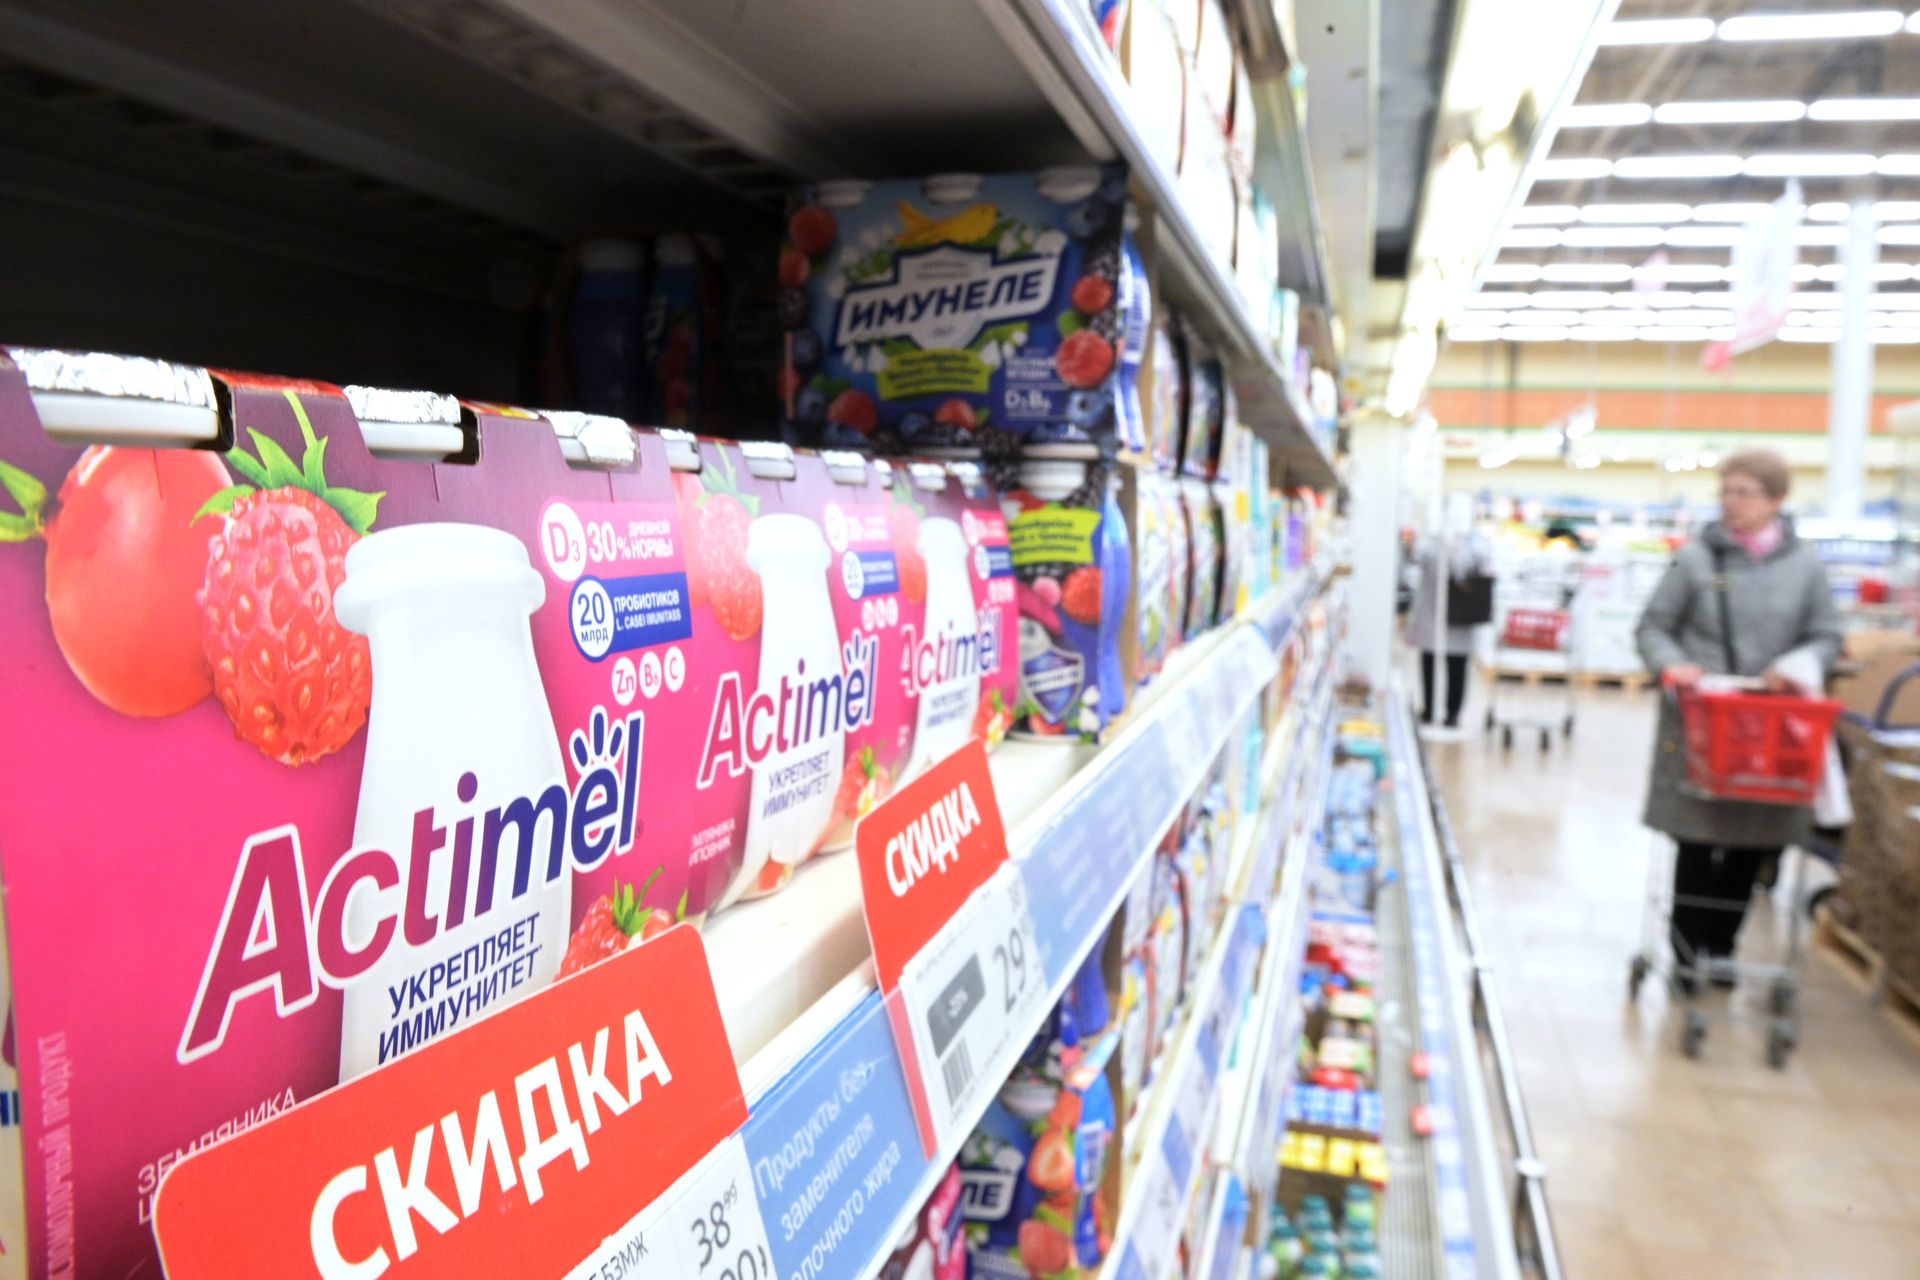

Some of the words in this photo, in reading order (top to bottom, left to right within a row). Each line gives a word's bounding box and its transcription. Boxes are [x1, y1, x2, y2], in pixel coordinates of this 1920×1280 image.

[848, 269, 1044, 331] ИМУНЕЛЕ
[548, 521, 581, 562] D3
[631, 539, 674, 560] НОРМЫ
[578, 592, 606, 627] 20
[581, 627, 609, 652] млрд
[613, 590, 680, 614] ПРОБИОТИКОВ
[615, 669, 635, 694] Zn
[669, 657, 679, 680] C
[696, 629, 879, 789] Actimel
[885, 782, 980, 897] СКИДКА
[177, 706, 645, 1065] Actimel
[378, 945, 542, 1065] ИММУНИТЕТ
[388, 912, 540, 1019] УКРЕПЛЯЕТ
[992, 927, 1027, 1014] 29
[310, 1009, 672, 1280] СКИДКА
[754, 1092, 841, 1199] Продукты
[781, 1114, 875, 1241] заменителя
[864, 1141, 900, 1200] жира
[691, 1201, 730, 1276] 38
